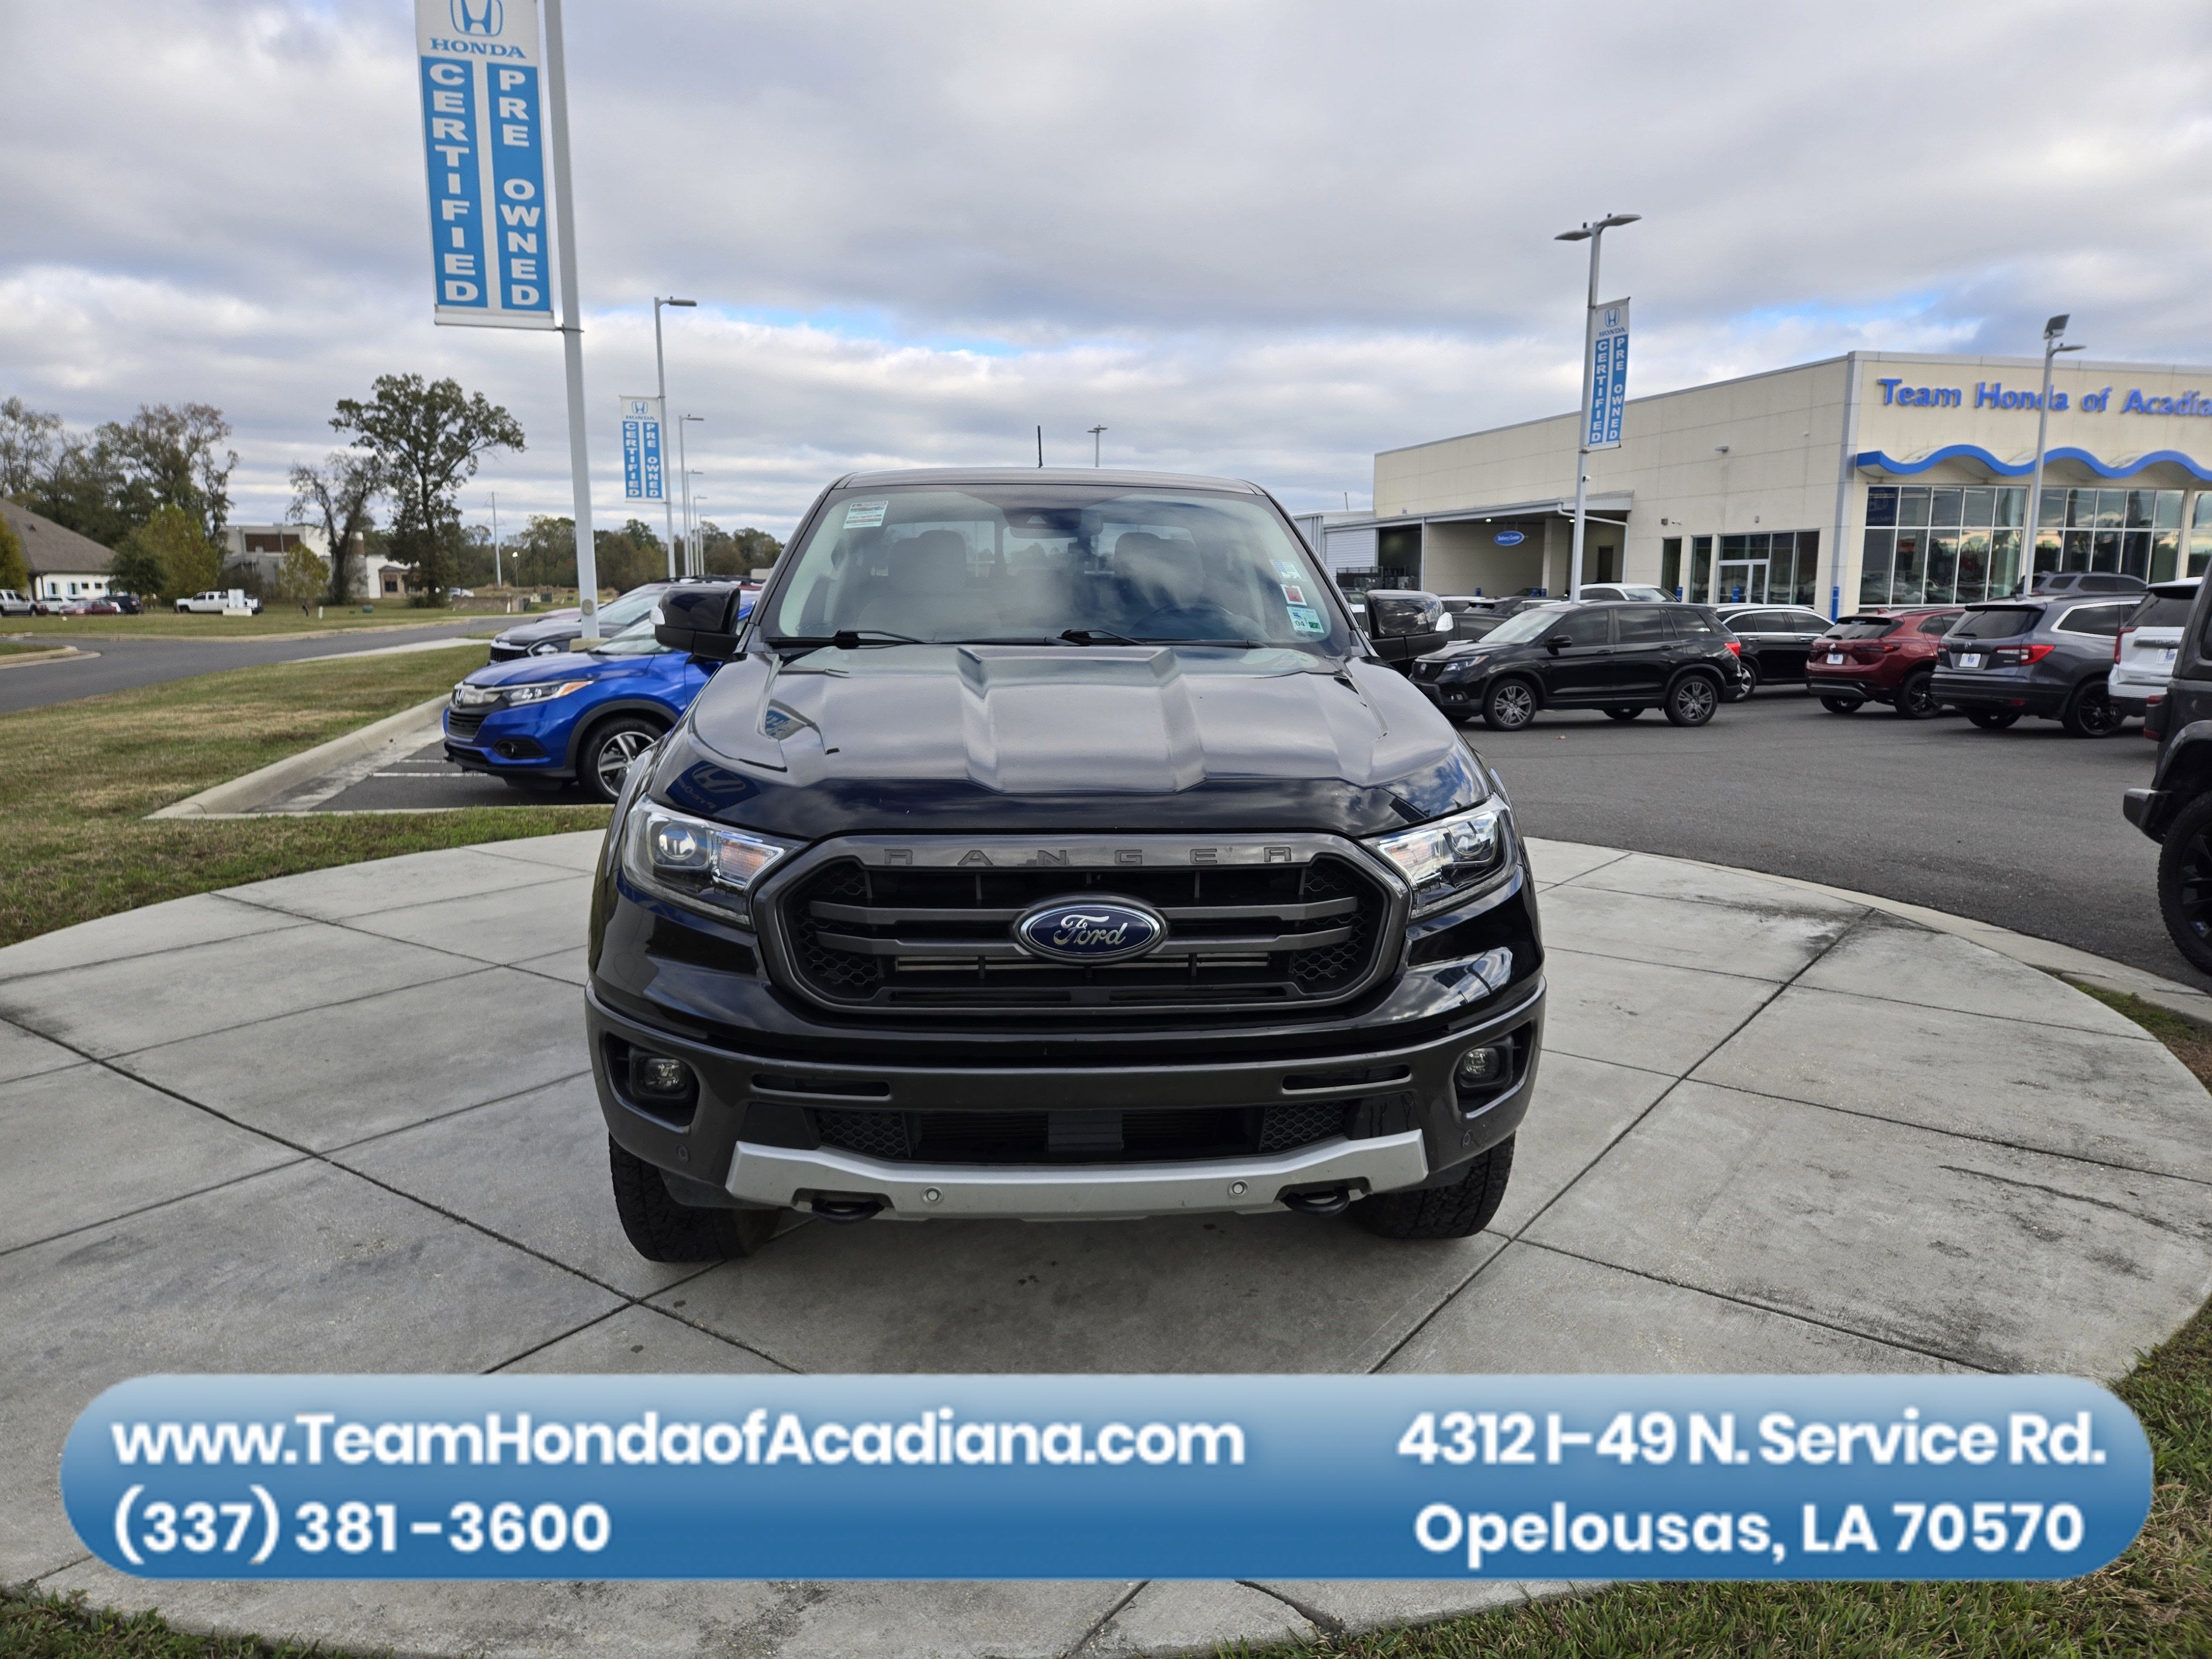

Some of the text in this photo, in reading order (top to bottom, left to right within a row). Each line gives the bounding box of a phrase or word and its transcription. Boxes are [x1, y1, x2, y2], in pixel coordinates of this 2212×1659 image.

[429, 37, 526, 58] HONDA
[429, 62, 479, 302] CERTIFIED
[498, 69, 541, 306] PRE OWNED
[1598, 326, 1626, 337] HONDA
[1591, 341, 1608, 442] CERTIFIED
[1609, 336, 1626, 440] PRE OWNED
[1877, 378, 1961, 406] Team
[1975, 381, 2070, 410] Honda
[2081, 386, 2113, 413] of
[624, 422, 640, 497] CERTIFIED
[646, 423, 659, 497] PRE OWNED
[885, 846, 1293, 866] RANGER
[1053, 913, 1128, 947] Ford
